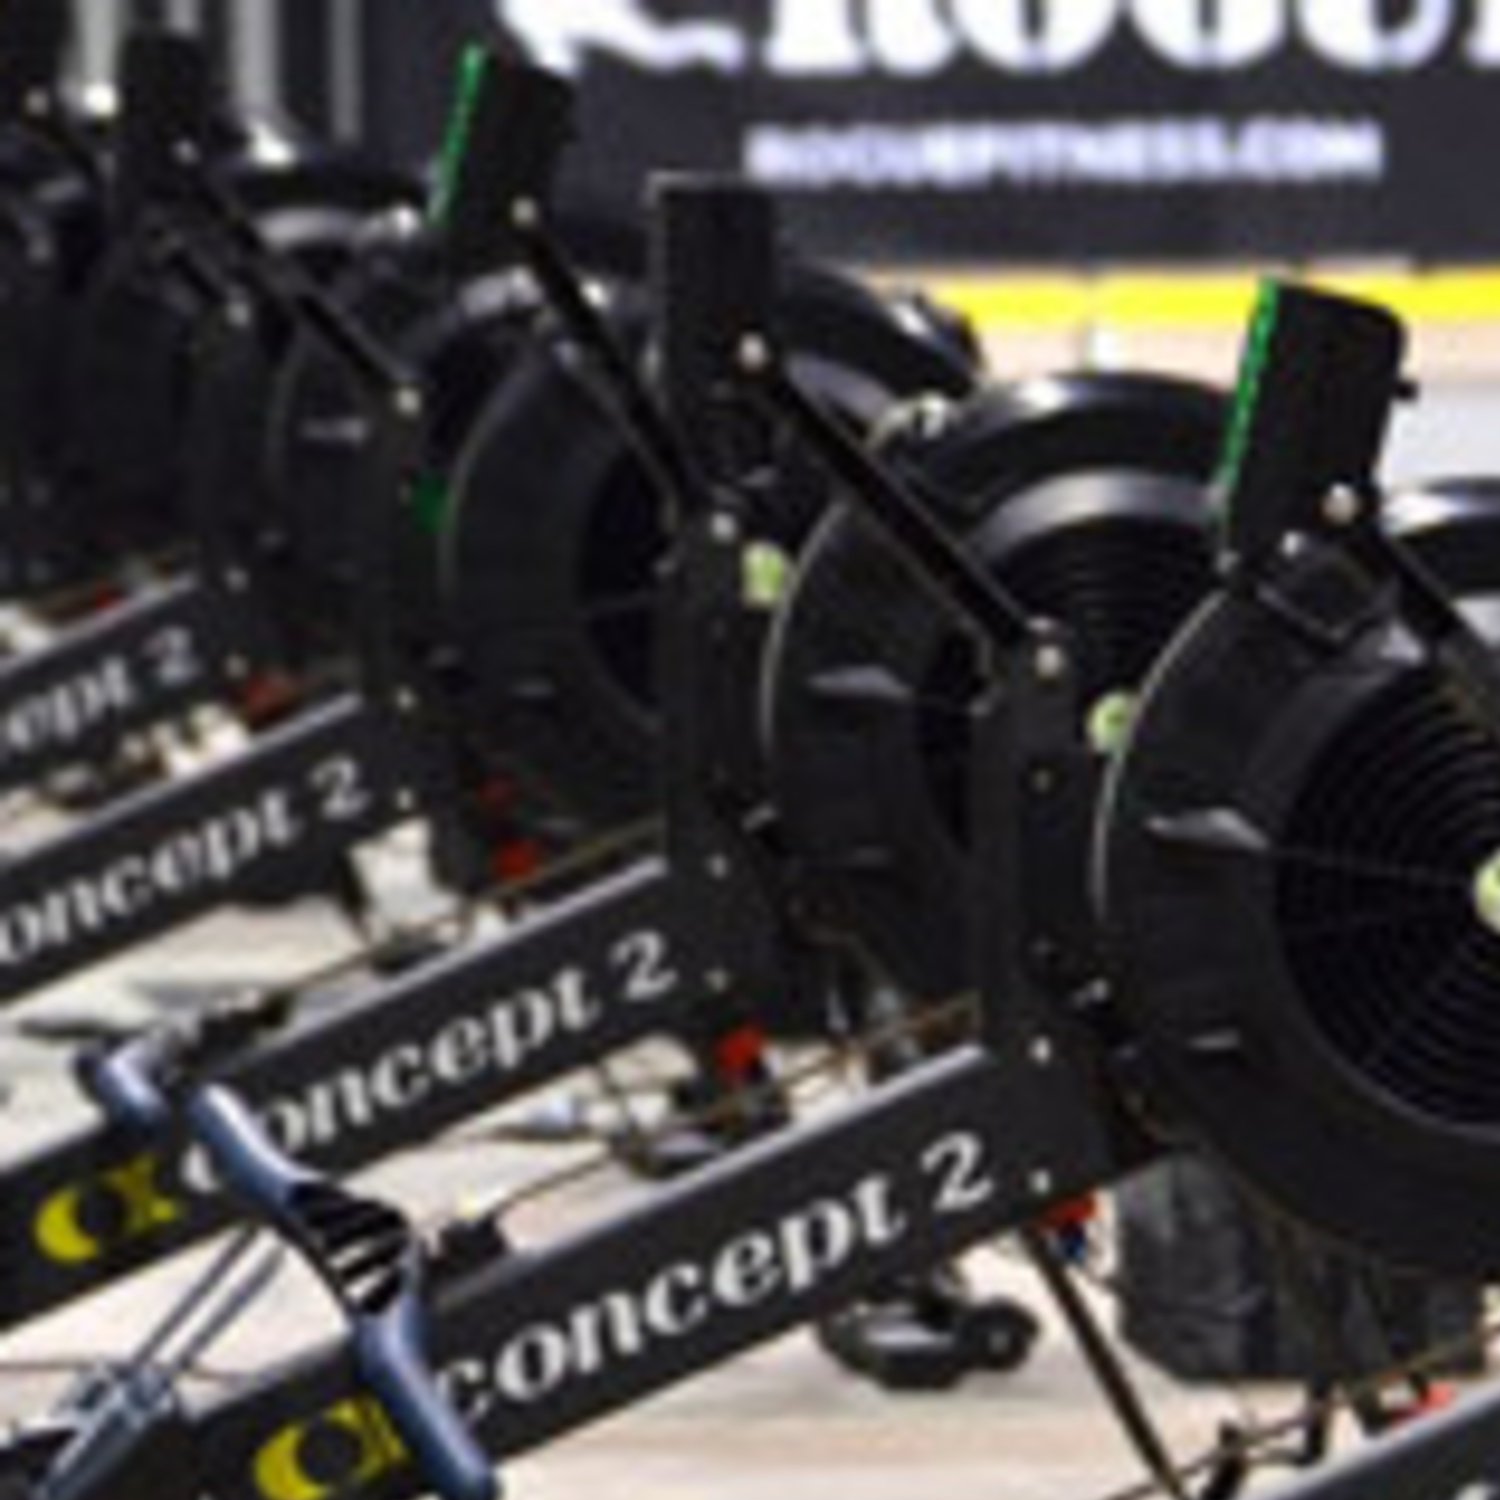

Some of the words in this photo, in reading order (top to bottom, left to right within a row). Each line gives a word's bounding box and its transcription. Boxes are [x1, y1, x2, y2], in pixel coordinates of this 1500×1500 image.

[145, 625, 200, 686] 2
[310, 756, 368, 818] 2
[611, 930, 676, 999] 2
[920, 1131, 994, 1212] 2
